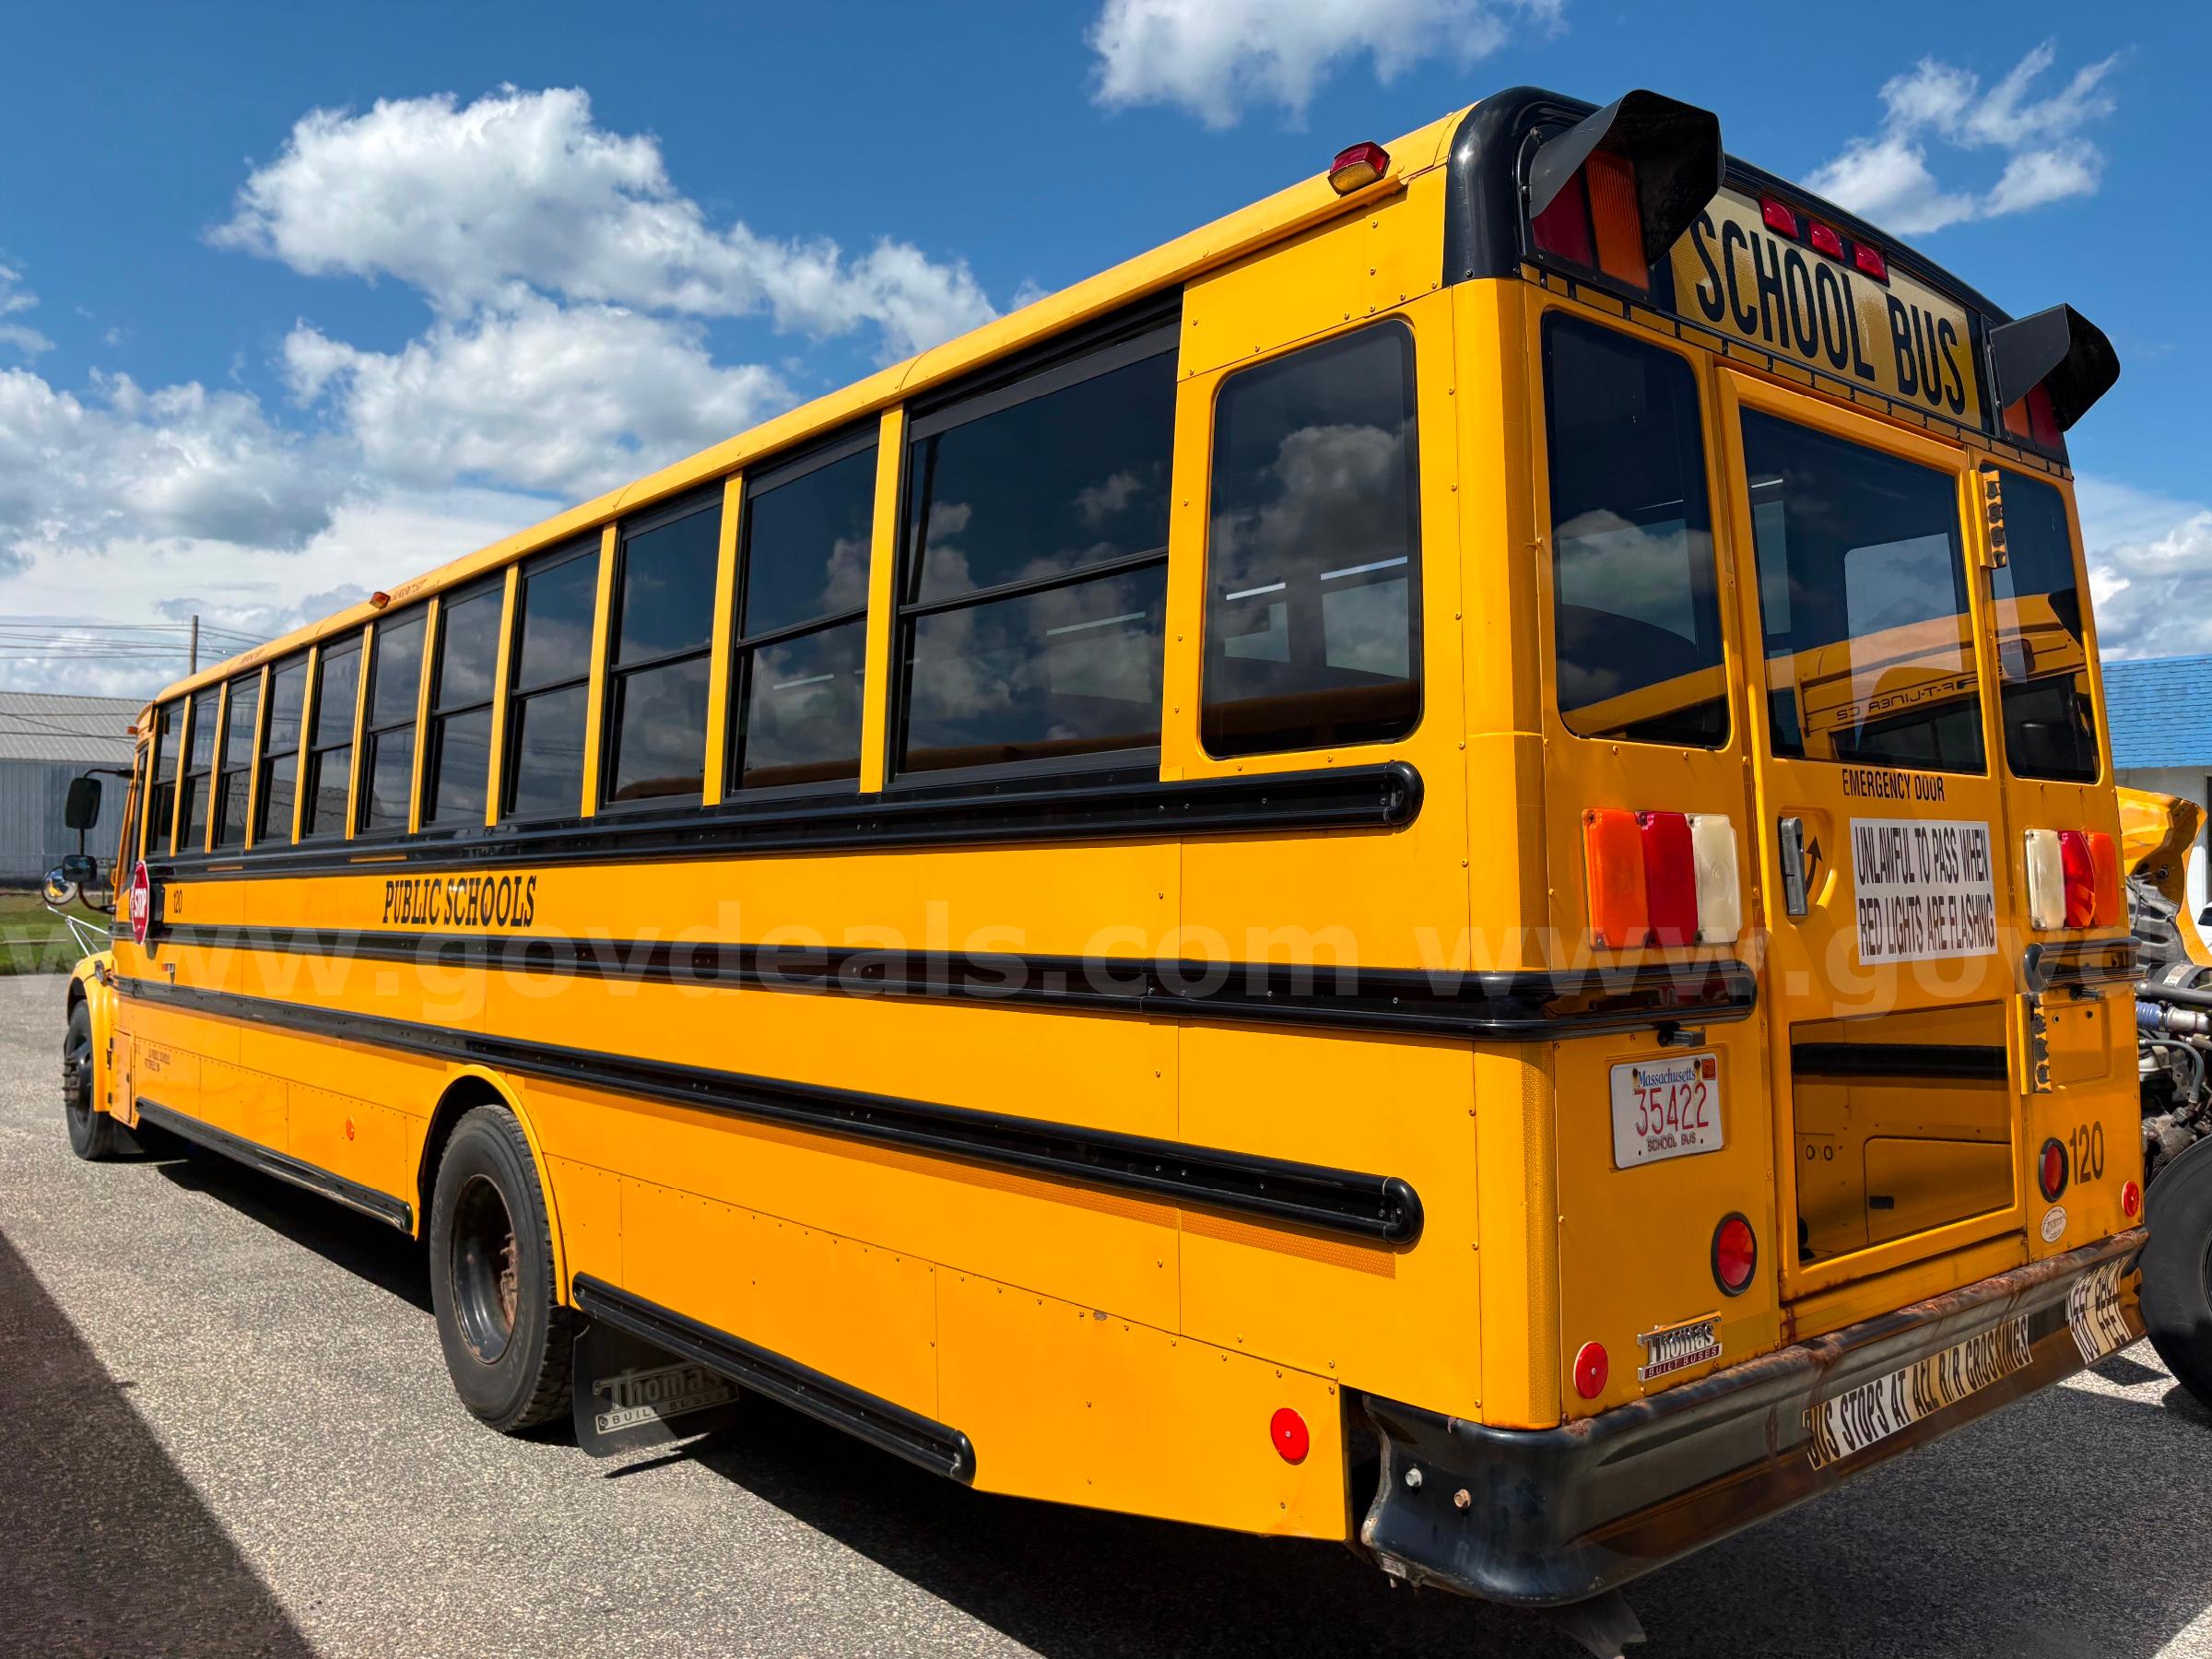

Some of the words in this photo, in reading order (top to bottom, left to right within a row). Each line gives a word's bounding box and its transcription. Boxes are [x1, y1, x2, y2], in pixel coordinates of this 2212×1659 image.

[1689, 207, 1876, 382] SCHOOL
[1886, 293, 1966, 416] BUS
[1842, 769, 1911, 800] EMERGENCY
[1914, 775, 1946, 802] DOOR
[1855, 826, 1915, 886] UNLAWFUL
[1914, 826, 1931, 884] TO
[1932, 827, 1959, 884] PASS
[1959, 828, 1989, 883] WHEN
[134, 888, 147, 918] STOP
[173, 889, 183, 914] 120
[382, 878, 442, 925] PUBLIC
[443, 875, 537, 928] SCHOOLS
[1858, 897, 1883, 957] RED
[1885, 895, 1924, 955] LIGHTS
[1926, 895, 1947, 952] ARE
[1947, 892, 1995, 949] FLASHING
[1638, 1067, 1697, 1088] Massachusetts
[1634, 1081, 1710, 1137] 35422
[1647, 1133, 1677, 1152] SCHOOL
[1681, 1131, 1697, 1147] BUS
[2069, 1121, 2104, 1185] 120
[1637, 1312, 1722, 1366] Thomas
[1648, 1360, 1679, 1377] BUILT
[1683, 1347, 1718, 1365] BUSES
[1840, 1380, 1890, 1452] STOPS
[1890, 1369, 1912, 1428] AT
[1912, 1359, 1940, 1417] ALL
[1938, 1347, 1966, 1403] R/R
[1965, 1316, 2032, 1391] CROSSINGS
